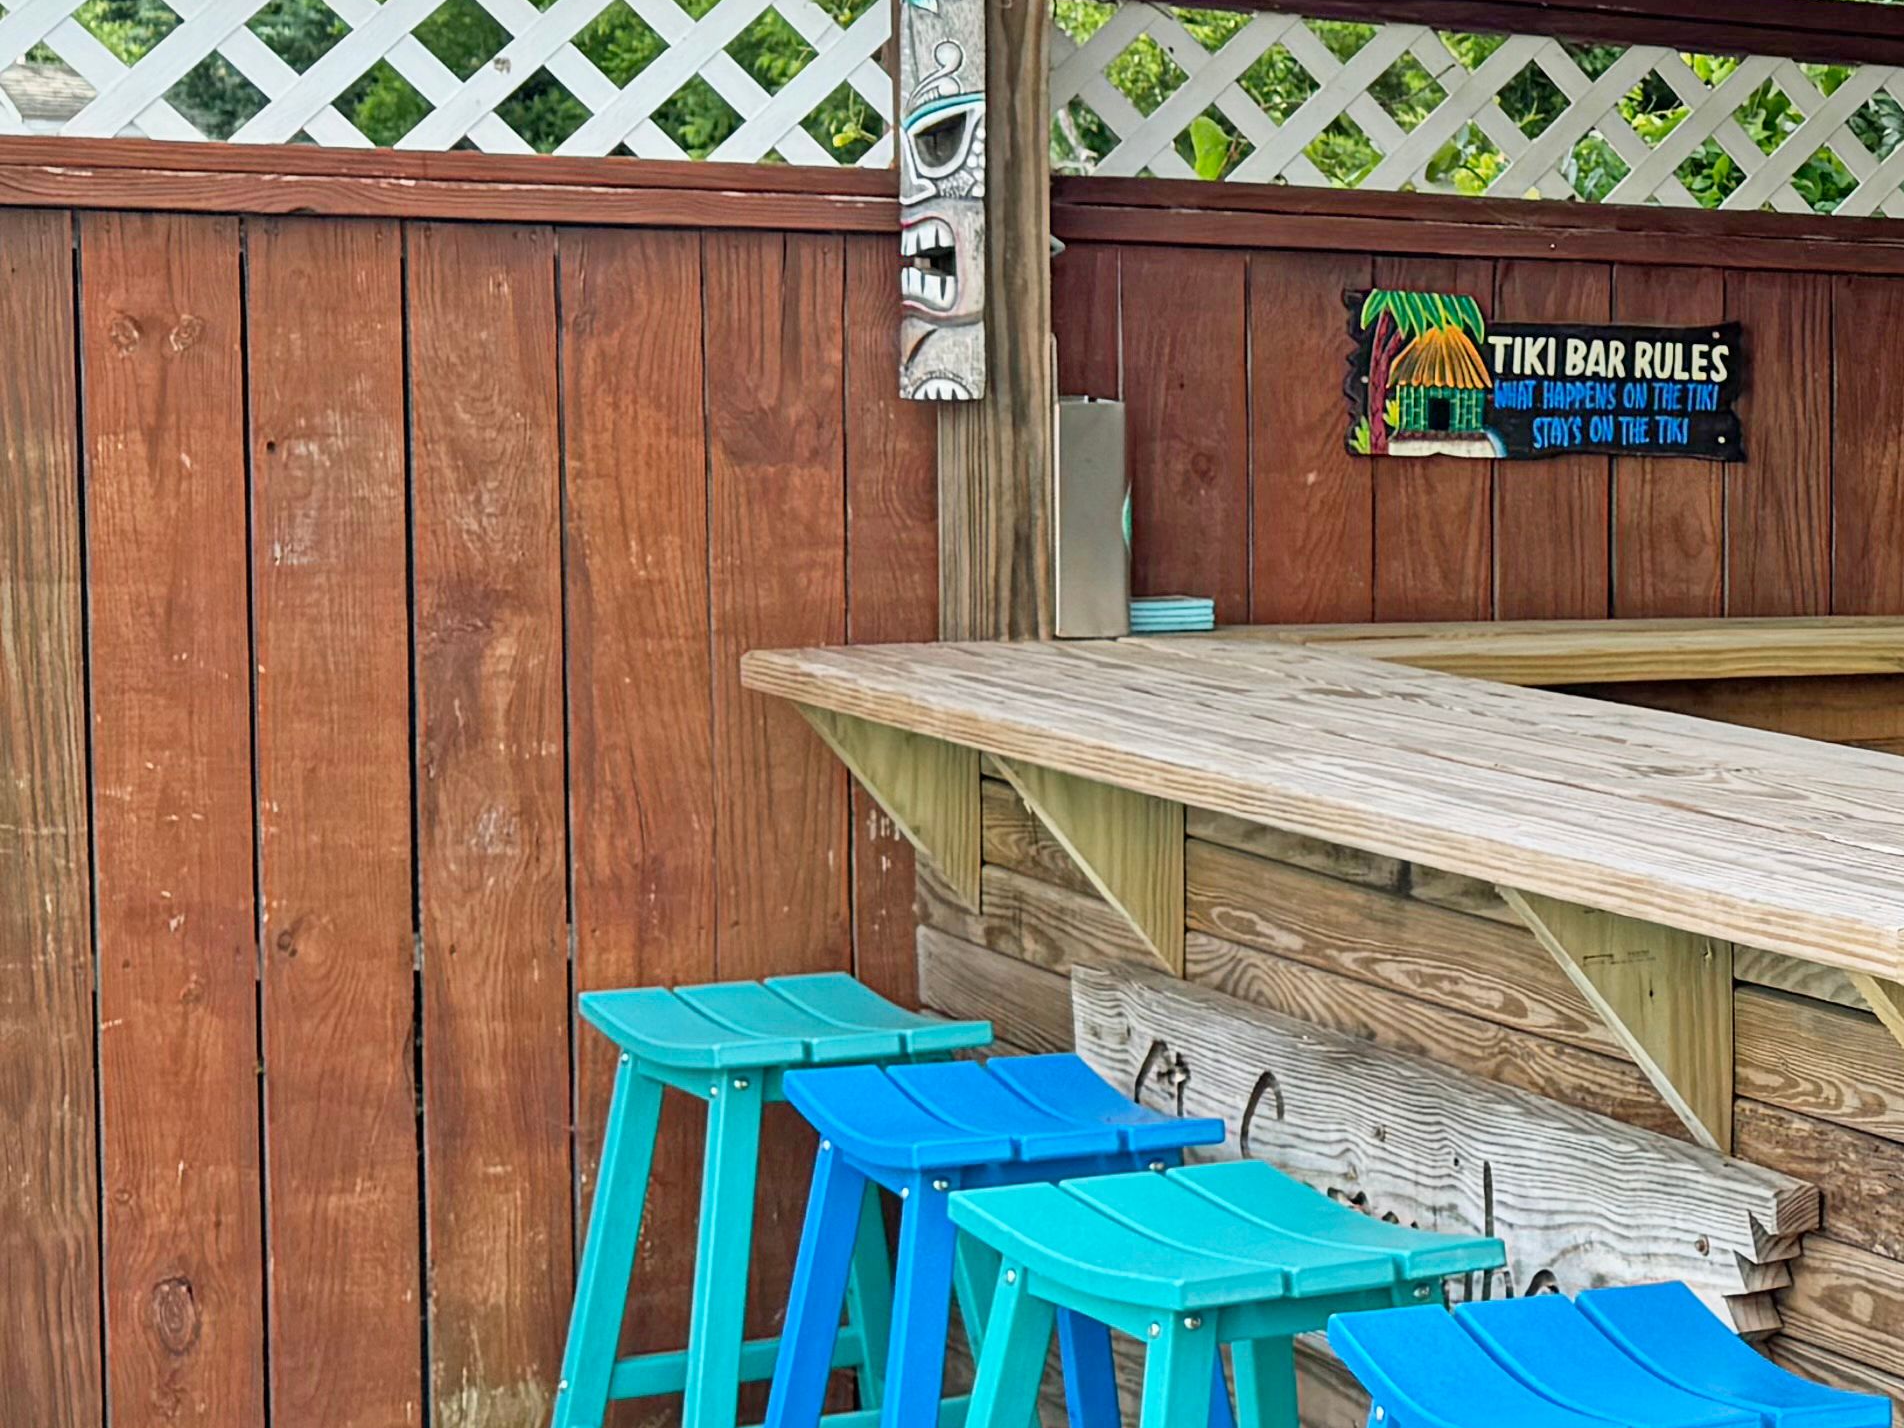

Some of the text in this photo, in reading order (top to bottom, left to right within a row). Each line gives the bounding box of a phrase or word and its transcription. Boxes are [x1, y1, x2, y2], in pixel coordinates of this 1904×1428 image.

[1487, 335, 1730, 383] TIKI BAR RULES
[1494, 380, 1719, 412] WHAT HAPPENS ON THE TIKI
[1532, 415, 1690, 449] STAYS ON THE TIKI
